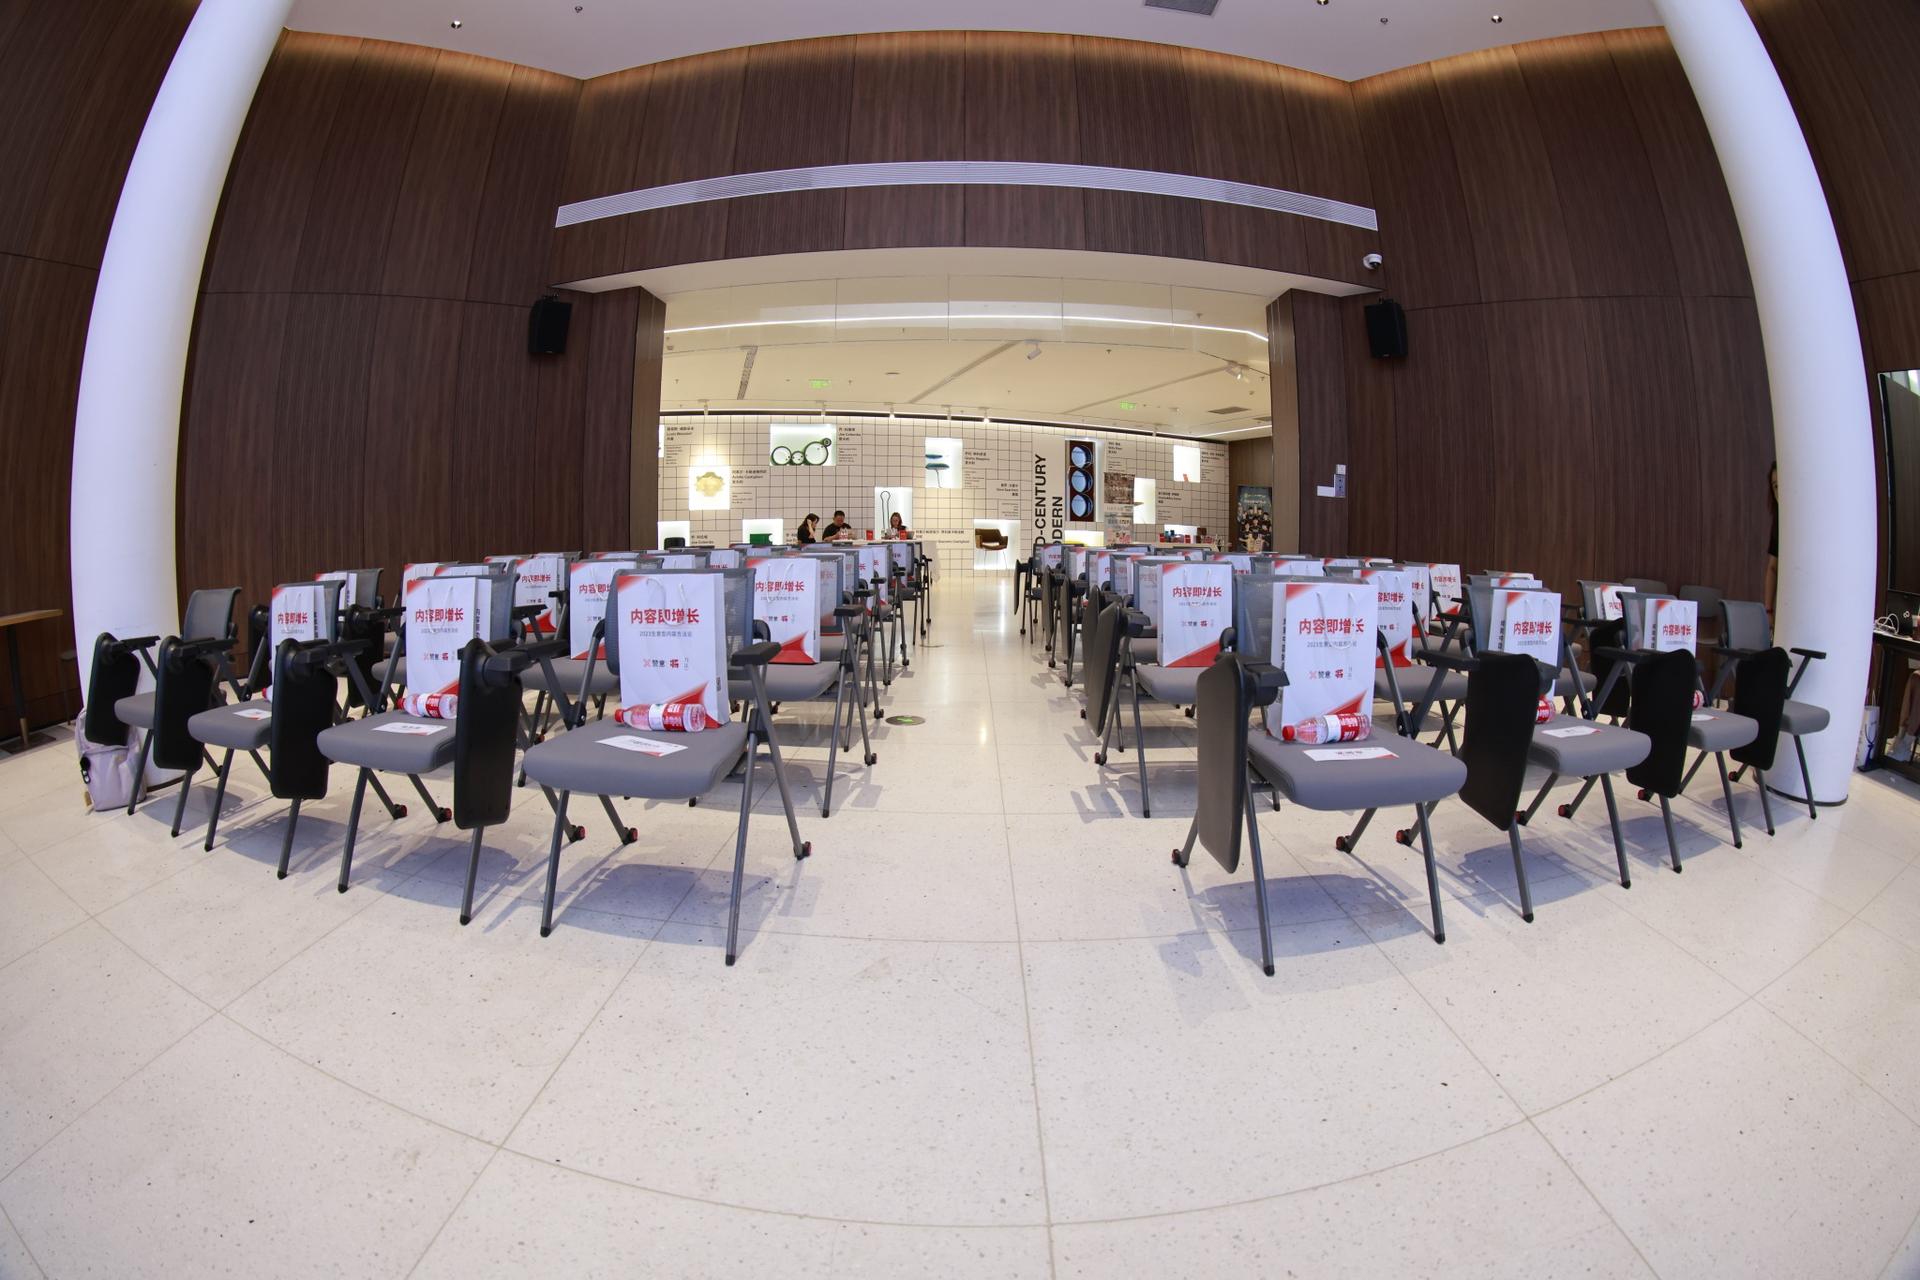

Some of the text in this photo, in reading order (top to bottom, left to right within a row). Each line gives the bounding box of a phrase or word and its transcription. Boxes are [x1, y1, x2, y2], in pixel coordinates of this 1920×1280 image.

[755, 581, 805, 592] 内容即增长
[1172, 587, 1222, 597] 内容即增长
[277, 612, 308, 625] 内容即增长
[415, 608, 464, 623] 内容即增长
[631, 608, 700, 624] 内容即增长
[1299, 618, 1364, 634] 内容即增长
[1513, 621, 1552, 635] 内容即增长
[1662, 624, 1692, 636] 内容即增长
